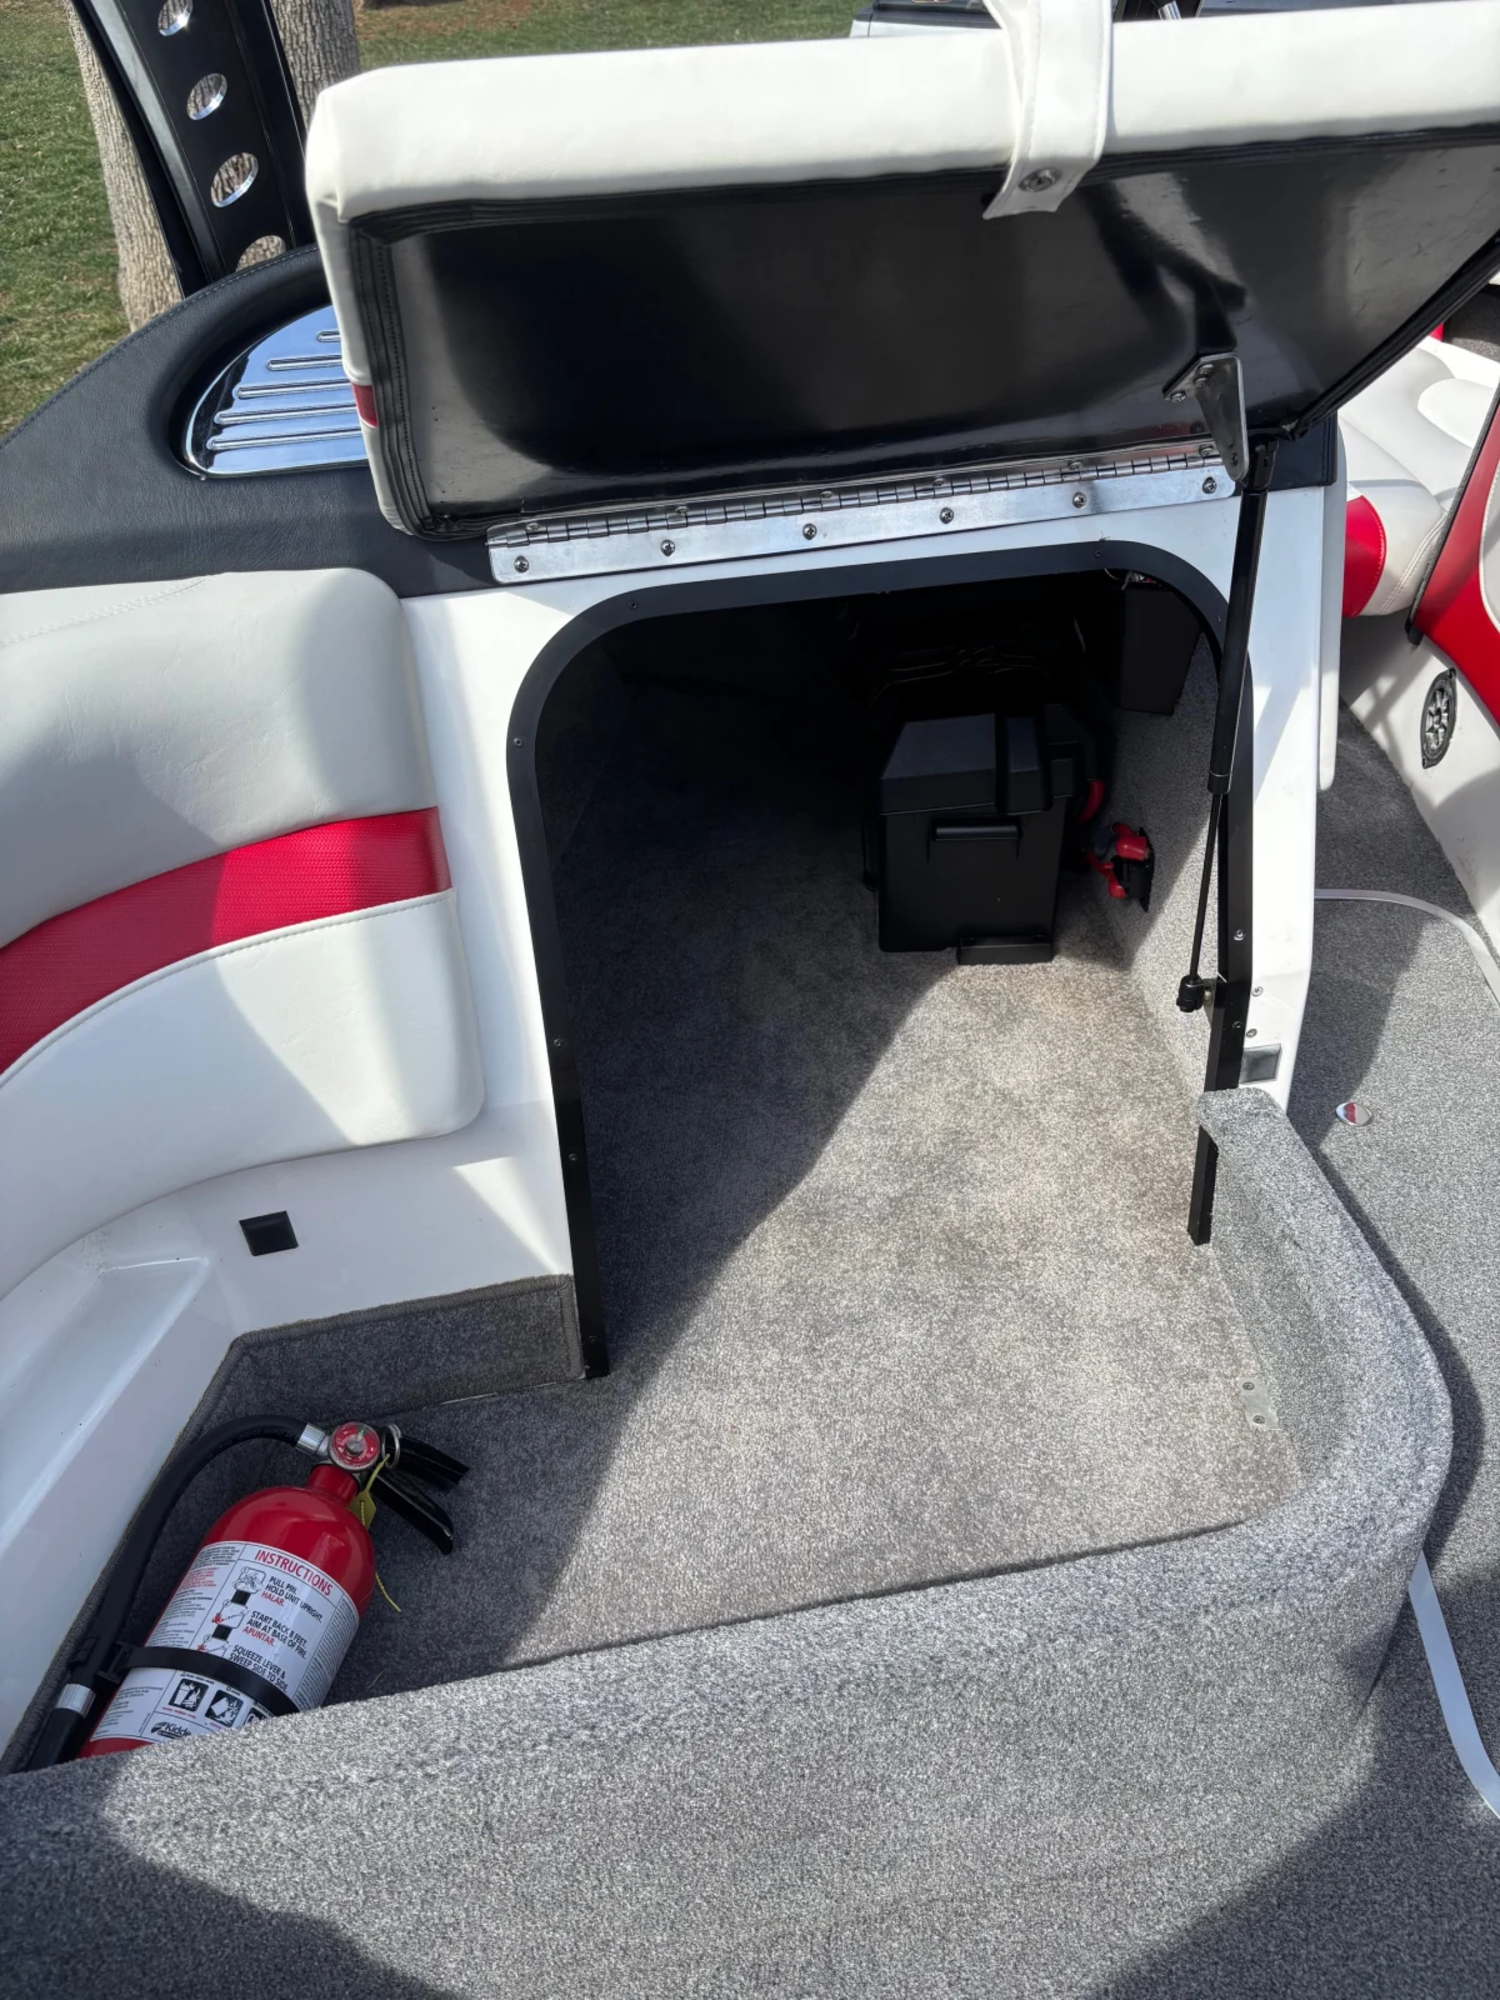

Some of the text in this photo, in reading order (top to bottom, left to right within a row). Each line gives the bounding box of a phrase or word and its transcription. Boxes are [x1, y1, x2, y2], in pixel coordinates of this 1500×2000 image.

[254, 1549, 333, 1596] INSTRUCTIONS
[269, 1576, 285, 1588] PULL
[261, 1591, 285, 1607] HALAR.
[265, 1584, 285, 1597] HOLD
[284, 1592, 300, 1605] UNIT
[299, 1601, 324, 1623] UPRIGHT.
[242, 1625, 275, 1647] APUNTAR.
[247, 1618, 262, 1630] AIM
[261, 1625, 272, 1635] AT
[271, 1629, 288, 1645] BASE
[287, 1638, 297, 1650] OF
[251, 1611, 273, 1625] START
[272, 1619, 290, 1635] BACK
[293, 1632, 308, 1648] FEET.
[228, 1652, 289, 1693] SWEEP SIDE TO SIDE.
[234, 1644, 264, 1665] SQUEEZE
[262, 1657, 281, 1675] LEVER
[280, 1670, 286, 1679] &
[164, 1721, 192, 1736] Kidde
